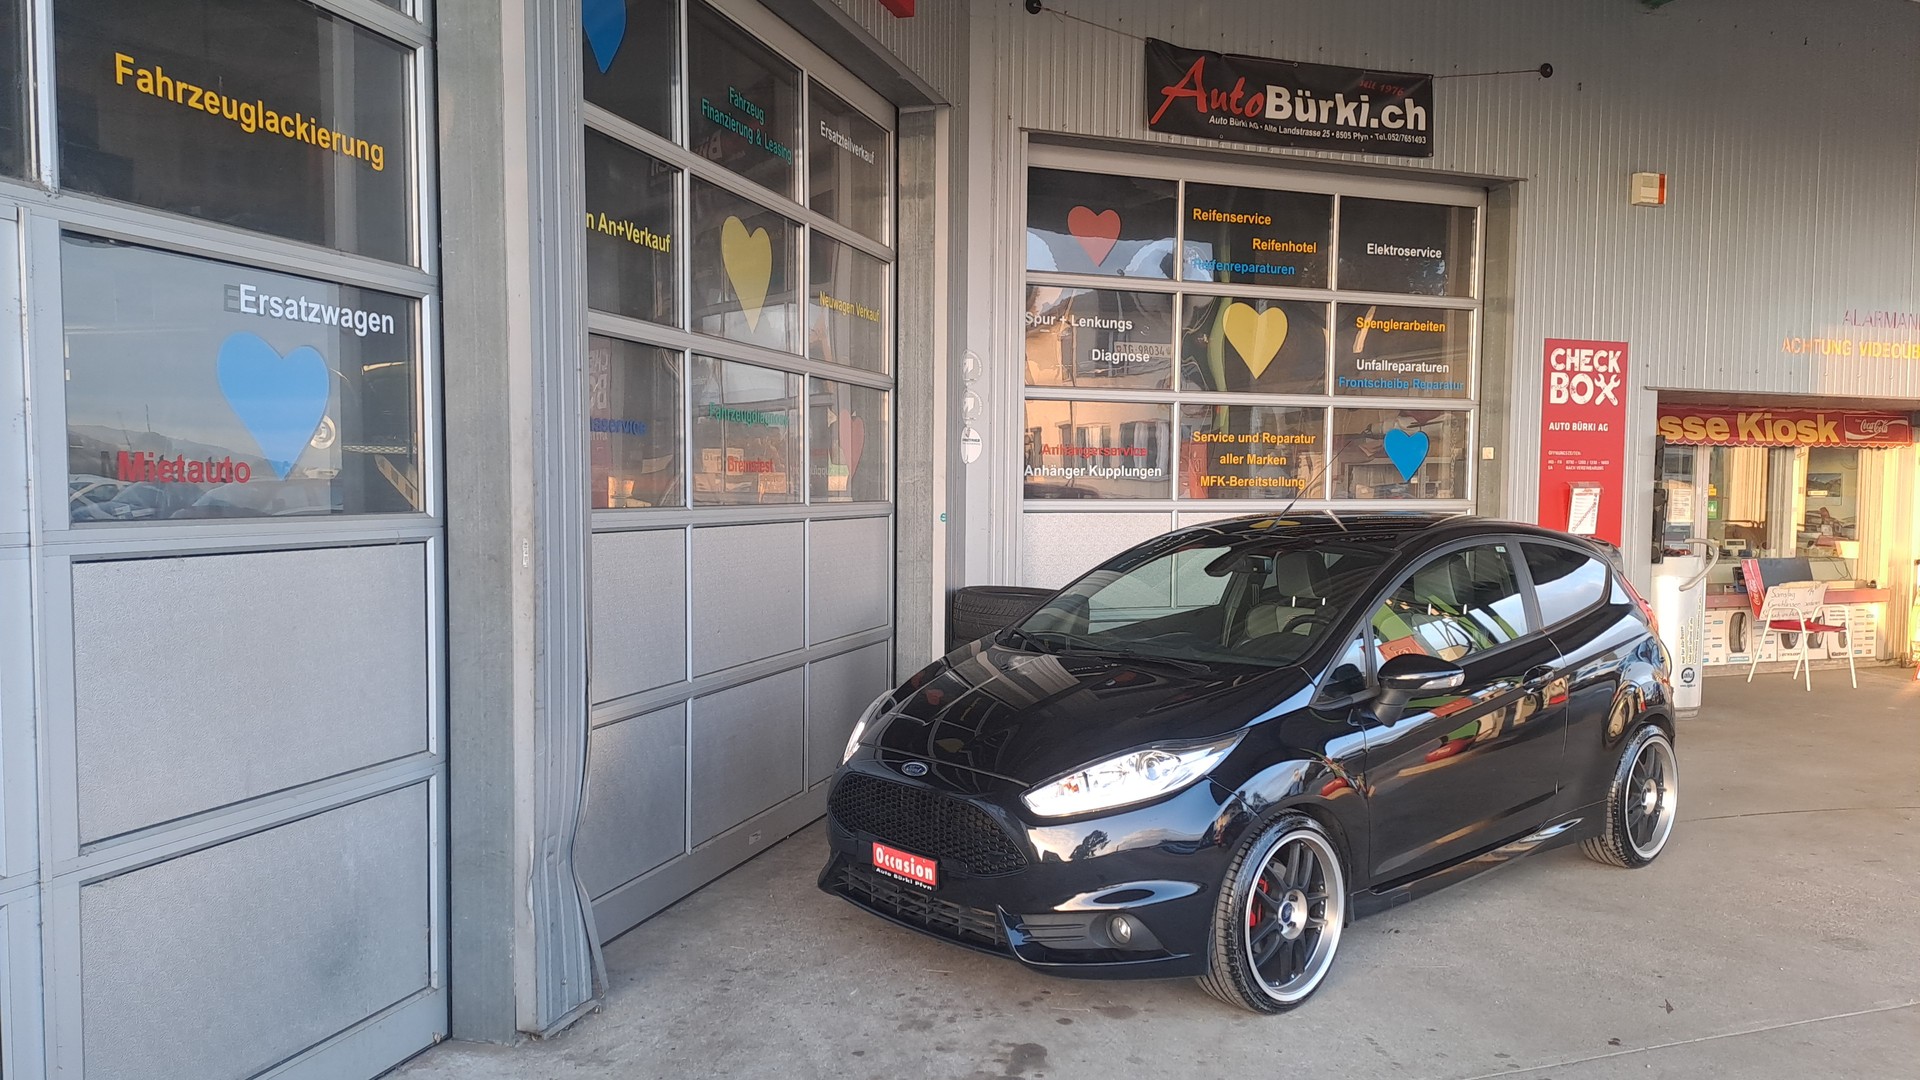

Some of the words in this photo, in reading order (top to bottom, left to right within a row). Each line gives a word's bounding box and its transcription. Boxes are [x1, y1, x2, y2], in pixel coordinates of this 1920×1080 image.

[115, 52, 385, 171] Fahrzeuglackierung
[728, 86, 765, 125] Fahrzeug
[701, 98, 753, 145] Finanzierung
[765, 132, 792, 165] Leasing
[1209, 115, 1228, 126] Auto
[1229, 117, 1248, 128] Bürki
[1249, 121, 1258, 130] AG
[1264, 124, 1277, 133] Alte
[1278, 126, 1321, 138] Landstrasse
[1322, 129, 1331, 138] 25
[1335, 130, 1351, 140] 8505
[1353, 132, 1369, 142] Pfyn
[820, 121, 875, 165] Ersatzteilverkauf
[1193, 208, 1271, 225] Reifenservice
[598, 212, 671, 253] An+Verkauf
[1252, 238, 1317, 253] Reifenhotel
[1366, 243, 1442, 259] Elektroservice
[1193, 259, 1295, 275] Reifenreparaturen
[239, 284, 394, 337] Ersatzwagen
[820, 291, 855, 317] Neuwagen
[855, 300, 880, 322] Verkauf
[1025, 312, 1056, 327] Spur
[1072, 315, 1133, 332] Lenkungs
[1356, 316, 1446, 333] Spenglerarbeiten
[1842, 309, 1920, 331] ALARMAN
[1781, 336, 1852, 356] ACHTUNG
[1091, 349, 1150, 364] Diagnose
[1550, 348, 1622, 374] CHECK
[1356, 359, 1450, 374] Unfallreparaturen
[1338, 376, 1409, 390] Frontscheibe
[1412, 379, 1464, 391] Reparatur
[1549, 422, 1570, 431] AUTO
[1572, 421, 1596, 431] BÜRKI
[1598, 423, 1608, 432] AG
[1656, 414, 1730, 442] sse
[1737, 412, 1840, 443] Kiosk
[1193, 431, 1235, 443] Service
[1238, 432, 1259, 443] und
[1262, 433, 1316, 446] Reparatur
[1042, 444, 1147, 459] Anhängerservice
[1219, 453, 1244, 465] aller
[1247, 454, 1287, 465] Marken
[117, 450, 251, 484] Mietauto
[727, 456, 774, 473] Bremstest
[1024, 465, 1086, 478] Anhänger
[1089, 465, 1162, 478] Kupplungen
[1200, 475, 1306, 489] MFK-Bereitstellung
[875, 847, 933, 881] Occasion
[876, 867, 892, 877] Auto
[893, 872, 913, 884] Bürki
